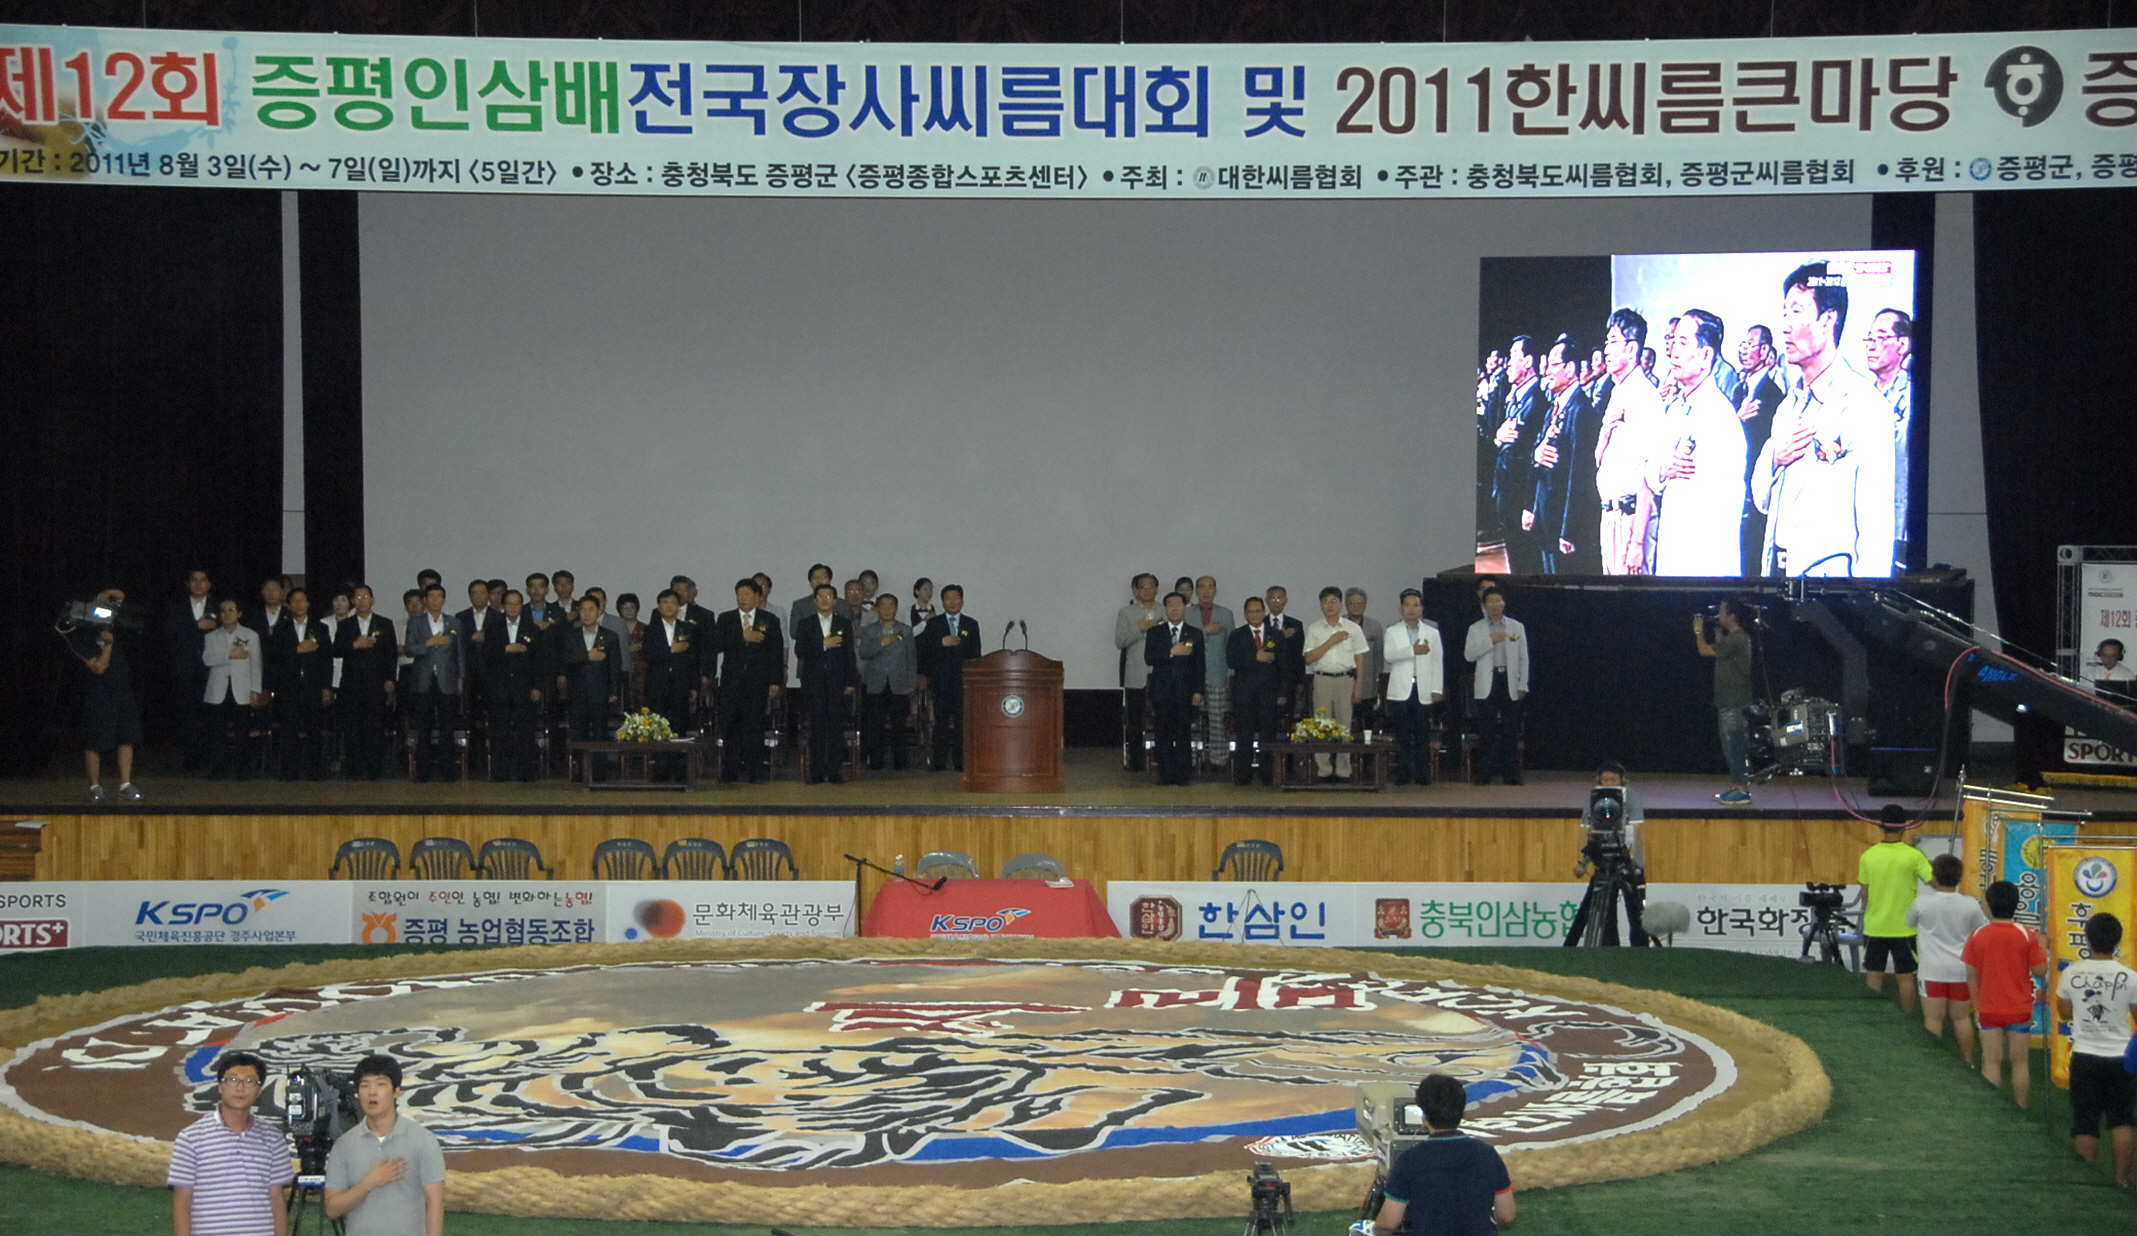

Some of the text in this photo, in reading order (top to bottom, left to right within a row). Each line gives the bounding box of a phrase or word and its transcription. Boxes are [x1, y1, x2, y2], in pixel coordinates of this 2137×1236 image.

[1244, 65, 1306, 138] 및
[70, 152, 150, 176] 2011년
[160, 153, 198, 177] 8월
[207, 154, 292, 181] 3일(수)
[661, 162, 757, 188] 충청북도
[766, 163, 838, 188] 증평군
[1121, 166, 1168, 190] 주최
[1218, 165, 1361, 190] 대한씨름협회
[1395, 165, 1443, 190] 주관
[1680, 159, 1855, 186] 증평군씨름협회
[1896, 157, 1945, 182] 후원
[135, 901, 249, 925] KSPO
[692, 902, 845, 926] 문화체육관광부
[930, 915, 1002, 932] KSPO
[1198, 902, 1325, 939] 한삼인
[135, 931, 226, 942] 국민체육진흥공단
[403, 918, 595, 944] 증평 농업협동조합
